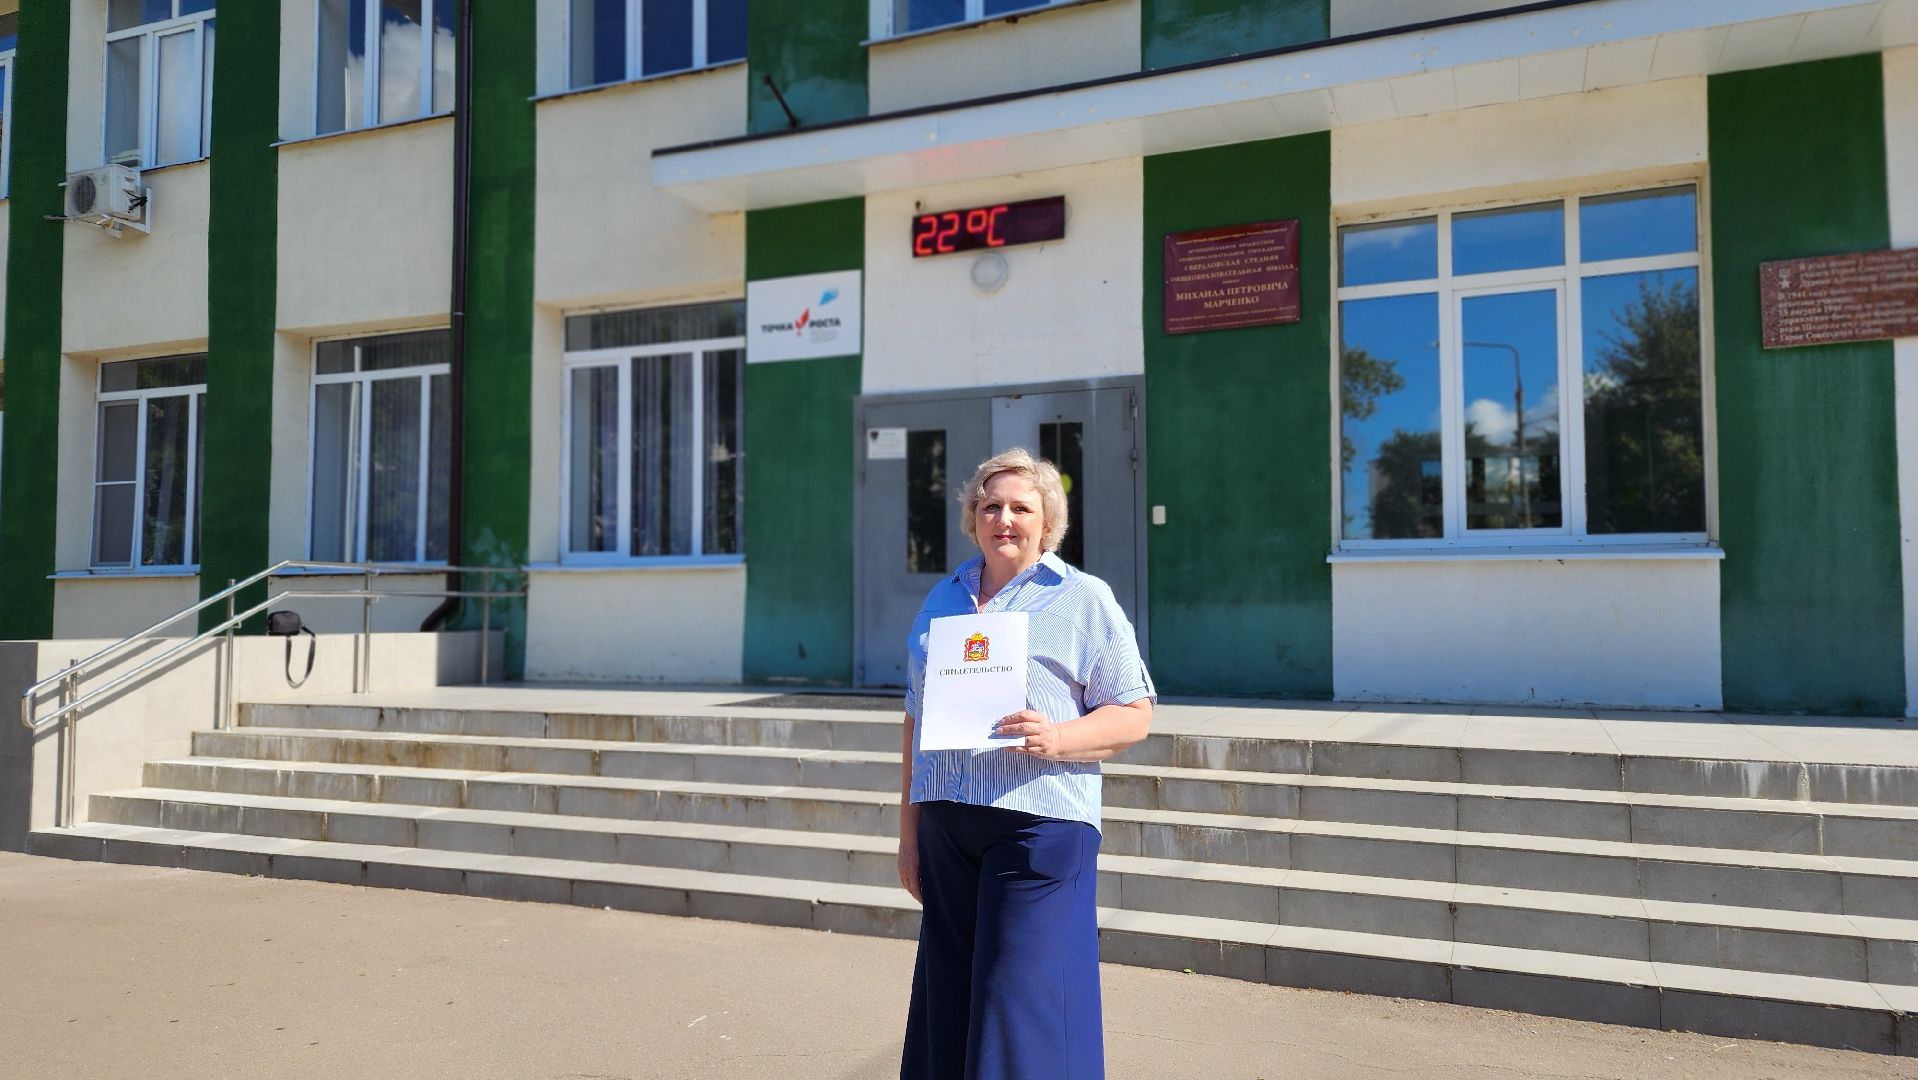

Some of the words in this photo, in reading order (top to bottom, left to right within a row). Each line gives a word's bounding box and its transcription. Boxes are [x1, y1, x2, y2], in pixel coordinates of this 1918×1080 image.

[915, 212, 960, 256] 22
[1184, 259, 1240, 271] СВЕРДЛОВСКАЯ
[1244, 254, 1280, 264] СРЕДНЯЯ
[1170, 267, 1262, 283] ОБЩЕОБРАЗОВАТЕЛЬНАЯ
[1266, 263, 1294, 272] ШКОЛА
[1176, 289, 1225, 301] МИХАИЛА
[1227, 281, 1289, 295] ПЕТРОВИЧА
[1203, 296, 1260, 309] МАРЧЕНКО
[761, 322, 794, 333] ТОЧКА
[809, 317, 841, 329] РОСТА
[939, 665, 1013, 676] СВИДЕТЕЛЬСТВО
